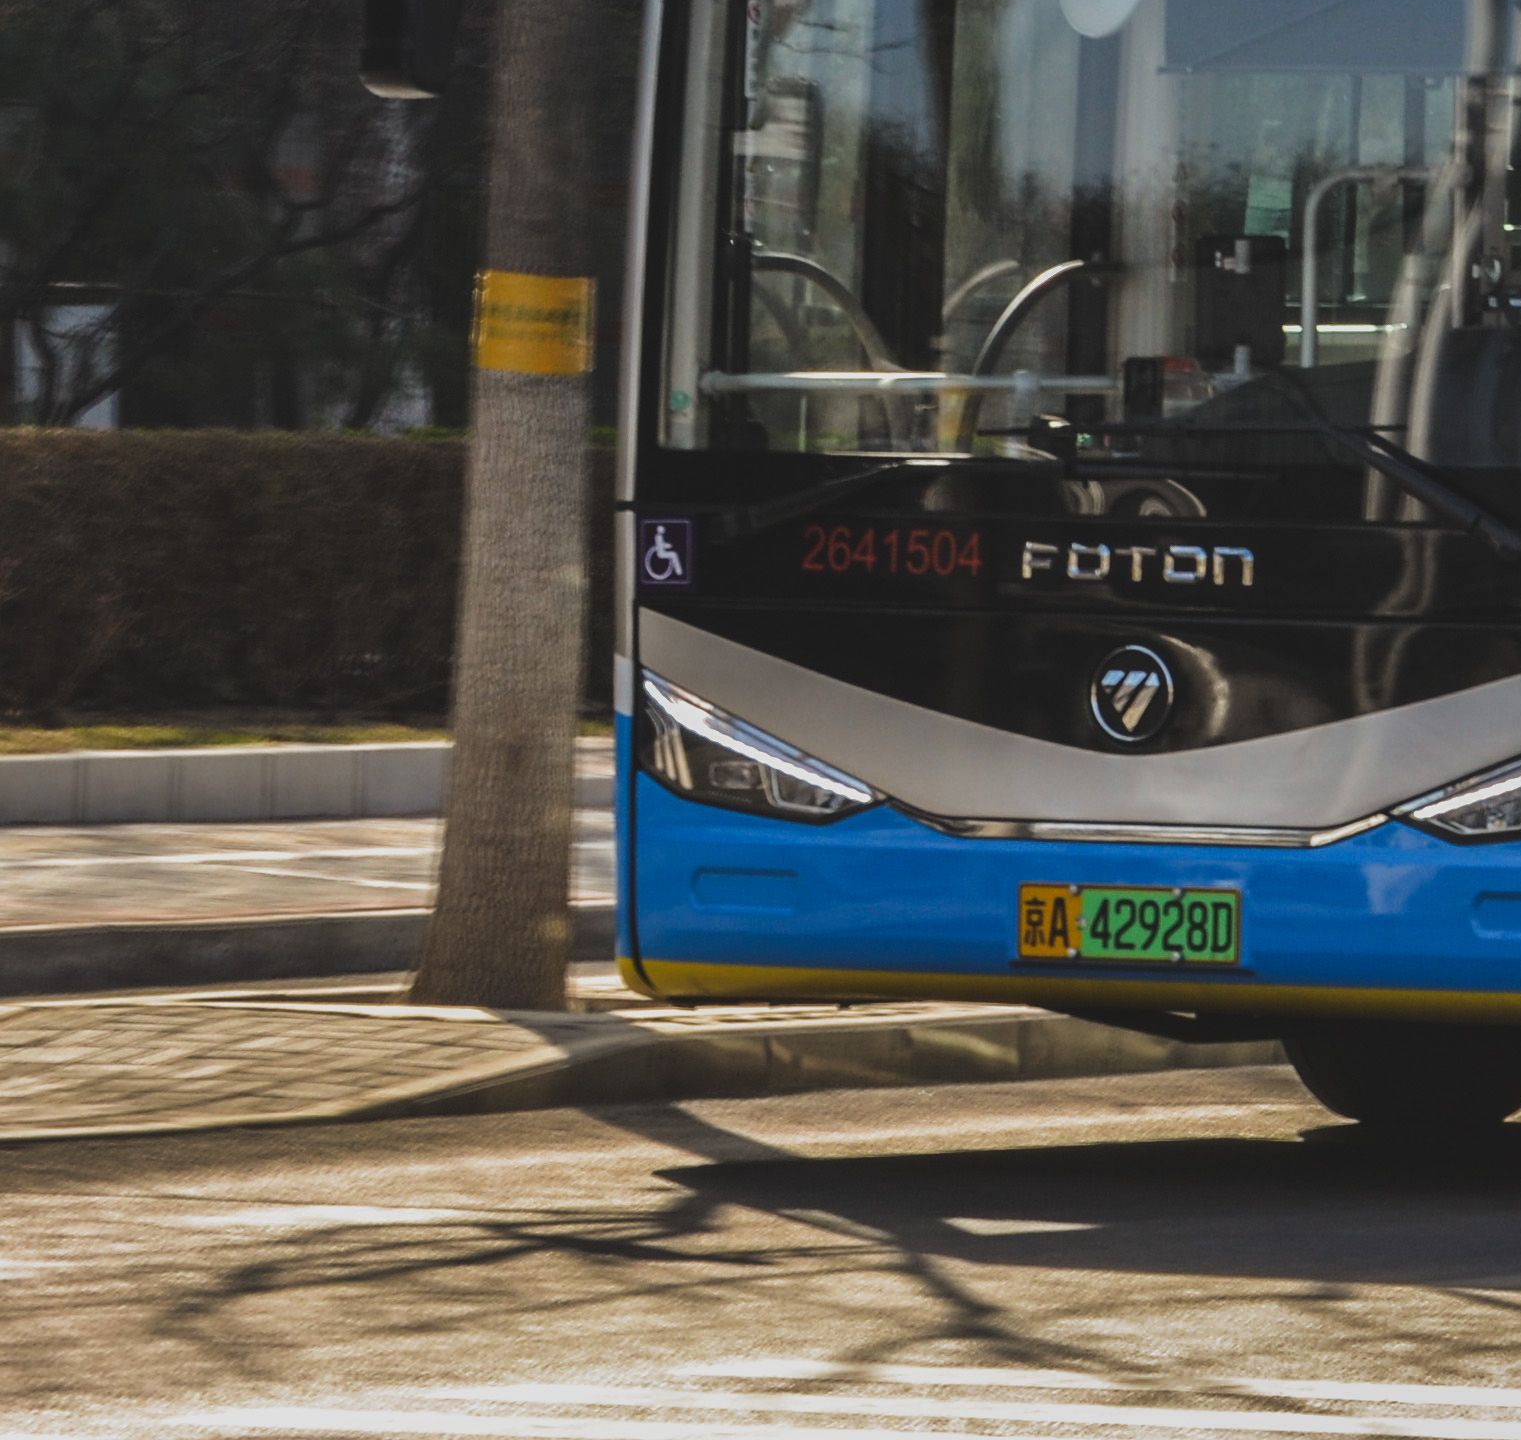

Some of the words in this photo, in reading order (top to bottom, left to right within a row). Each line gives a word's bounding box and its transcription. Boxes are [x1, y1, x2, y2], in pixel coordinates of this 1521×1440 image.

[802, 525, 983, 577] 2641504
[1022, 541, 1255, 586] FOTON
[1024, 896, 1069, 948] 京A
[1089, 897, 1233, 953] 42928D
